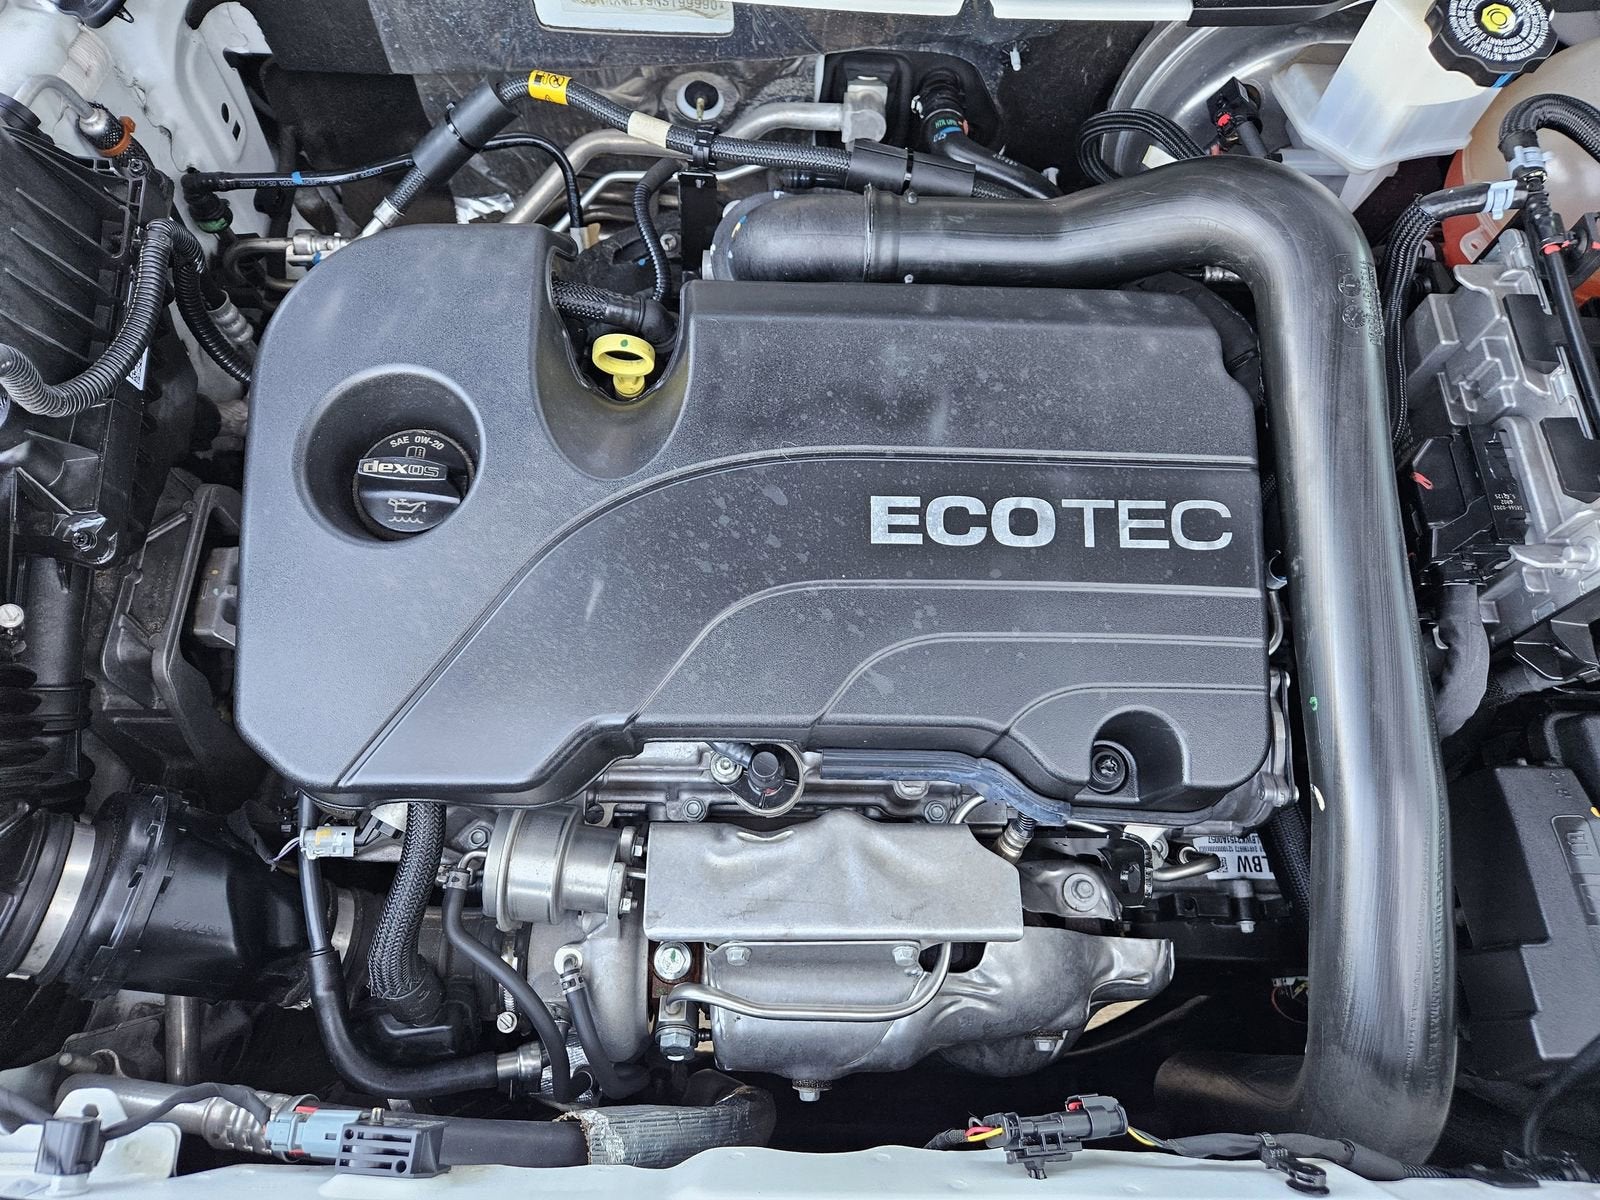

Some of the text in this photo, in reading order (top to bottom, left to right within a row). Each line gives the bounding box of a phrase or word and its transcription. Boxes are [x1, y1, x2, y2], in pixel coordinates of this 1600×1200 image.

[389, 435, 445, 450] SAE 0W-20
[363, 460, 440, 477] dexos
[870, 495, 1233, 550] ECOTEC
